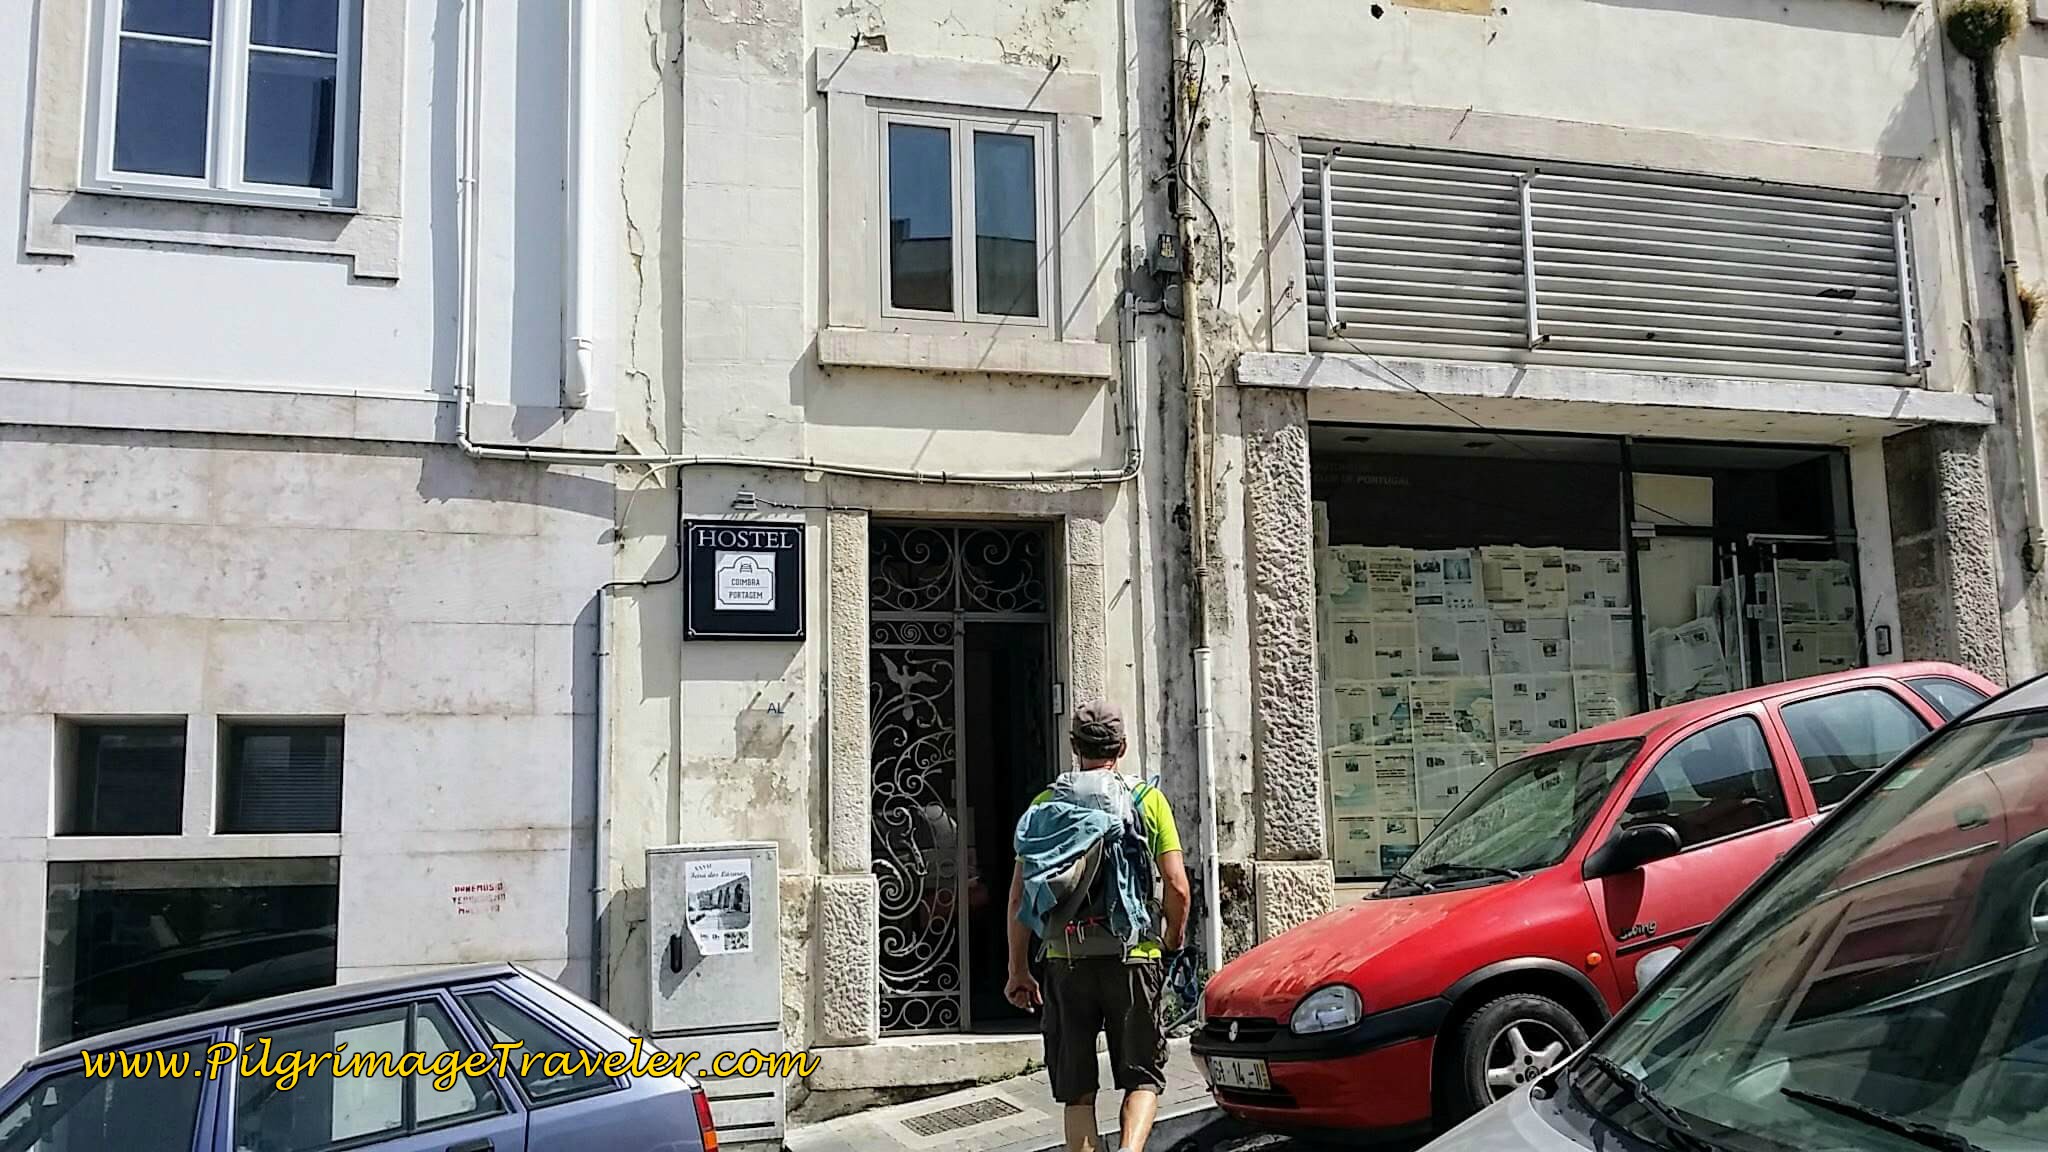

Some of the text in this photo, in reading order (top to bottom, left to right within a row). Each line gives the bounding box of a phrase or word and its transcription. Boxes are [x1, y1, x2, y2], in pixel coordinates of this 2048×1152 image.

[697, 529, 793, 549] HOSTEL
[731, 577, 760, 586] COIMBRA
[728, 590, 763, 600] PORTAGEM
[767, 702, 784, 714] AL
